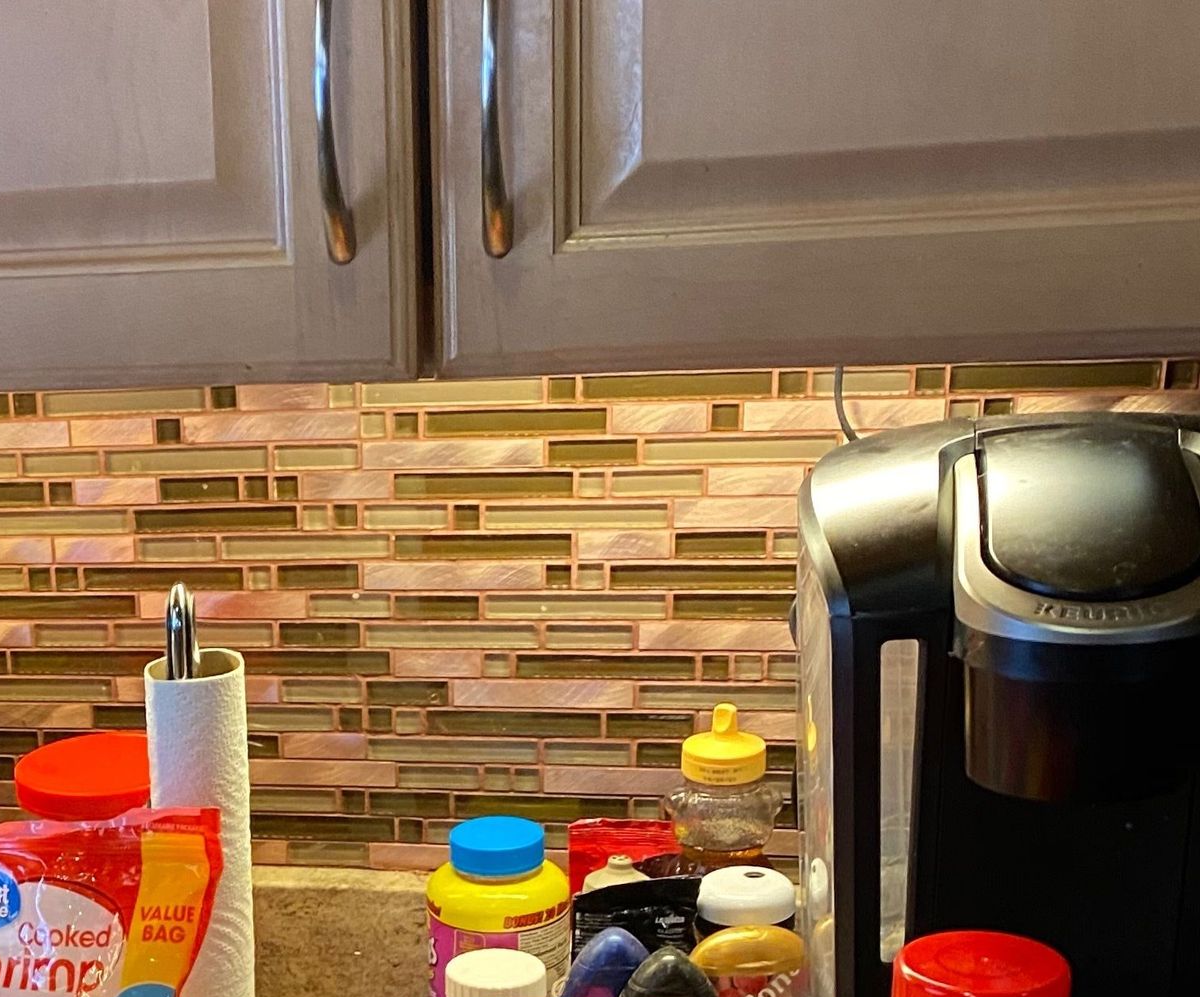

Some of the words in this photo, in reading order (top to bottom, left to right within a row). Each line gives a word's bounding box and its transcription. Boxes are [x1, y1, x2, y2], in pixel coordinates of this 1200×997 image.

[141, 905, 195, 923] VALUE
[18, 921, 111, 947] Cooked
[142, 925, 186, 943] BAG
